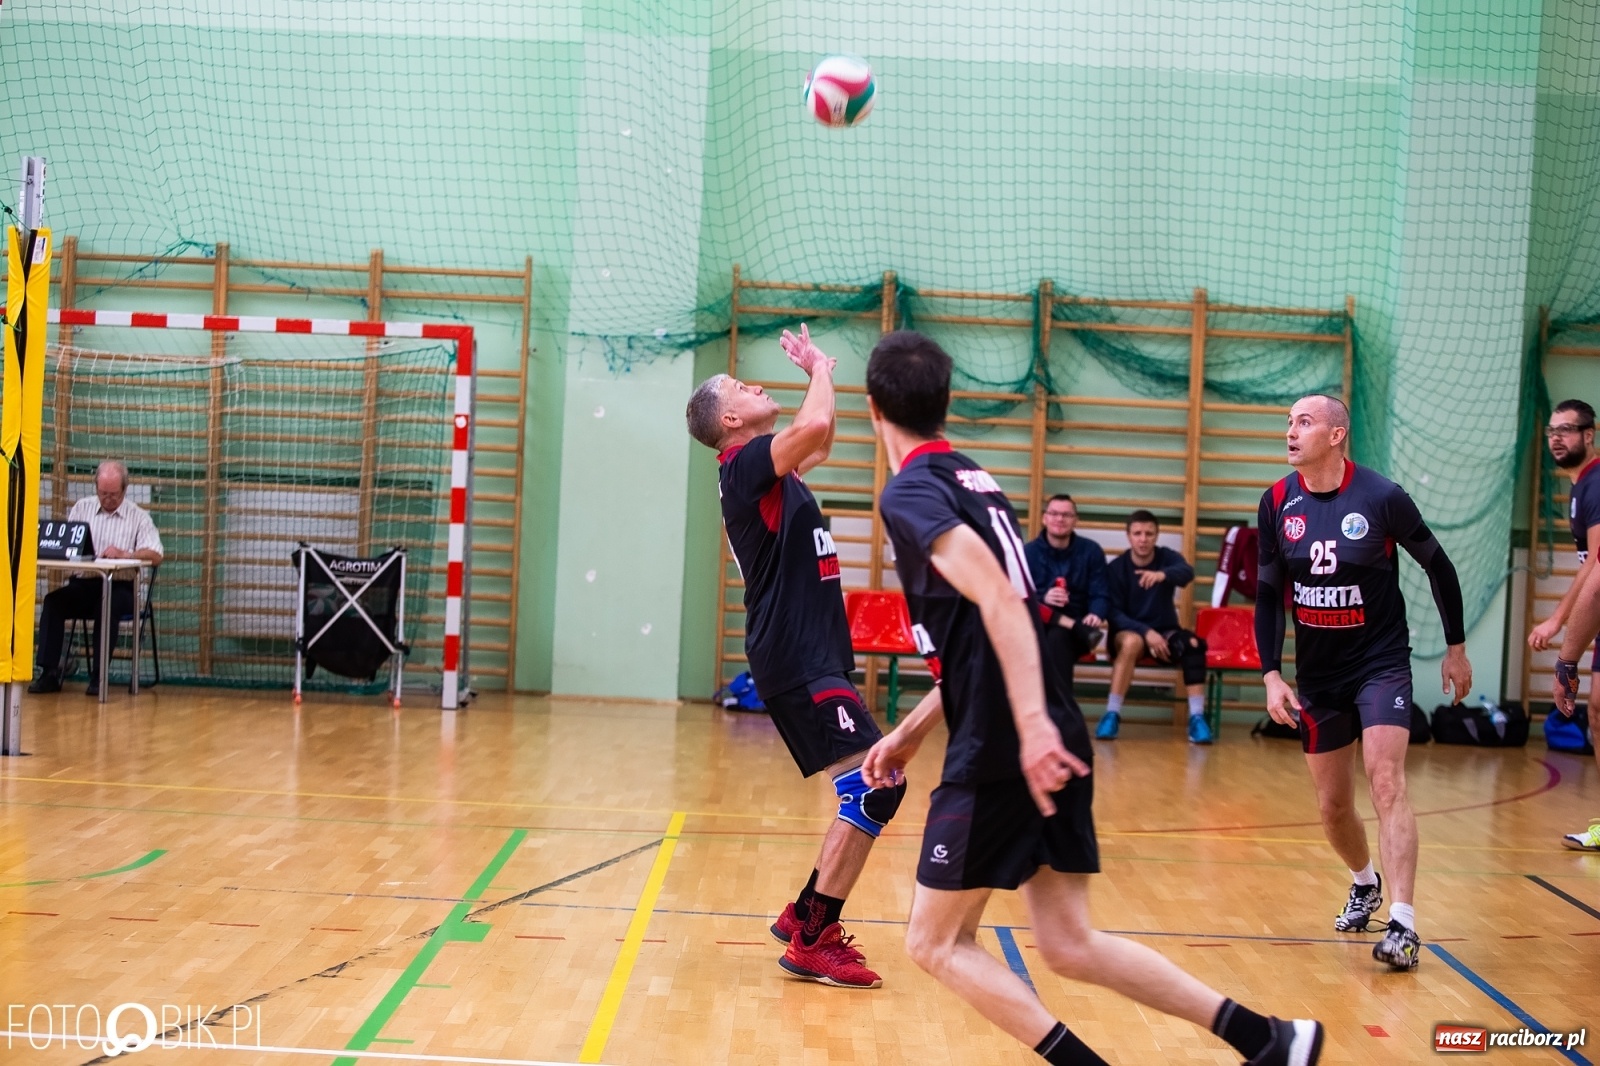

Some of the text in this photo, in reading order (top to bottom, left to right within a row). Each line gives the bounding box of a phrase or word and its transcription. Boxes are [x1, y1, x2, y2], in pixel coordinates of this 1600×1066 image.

[70, 524, 86, 545] 19
[1309, 539, 1337, 575] 25
[837, 704, 856, 733] 4
